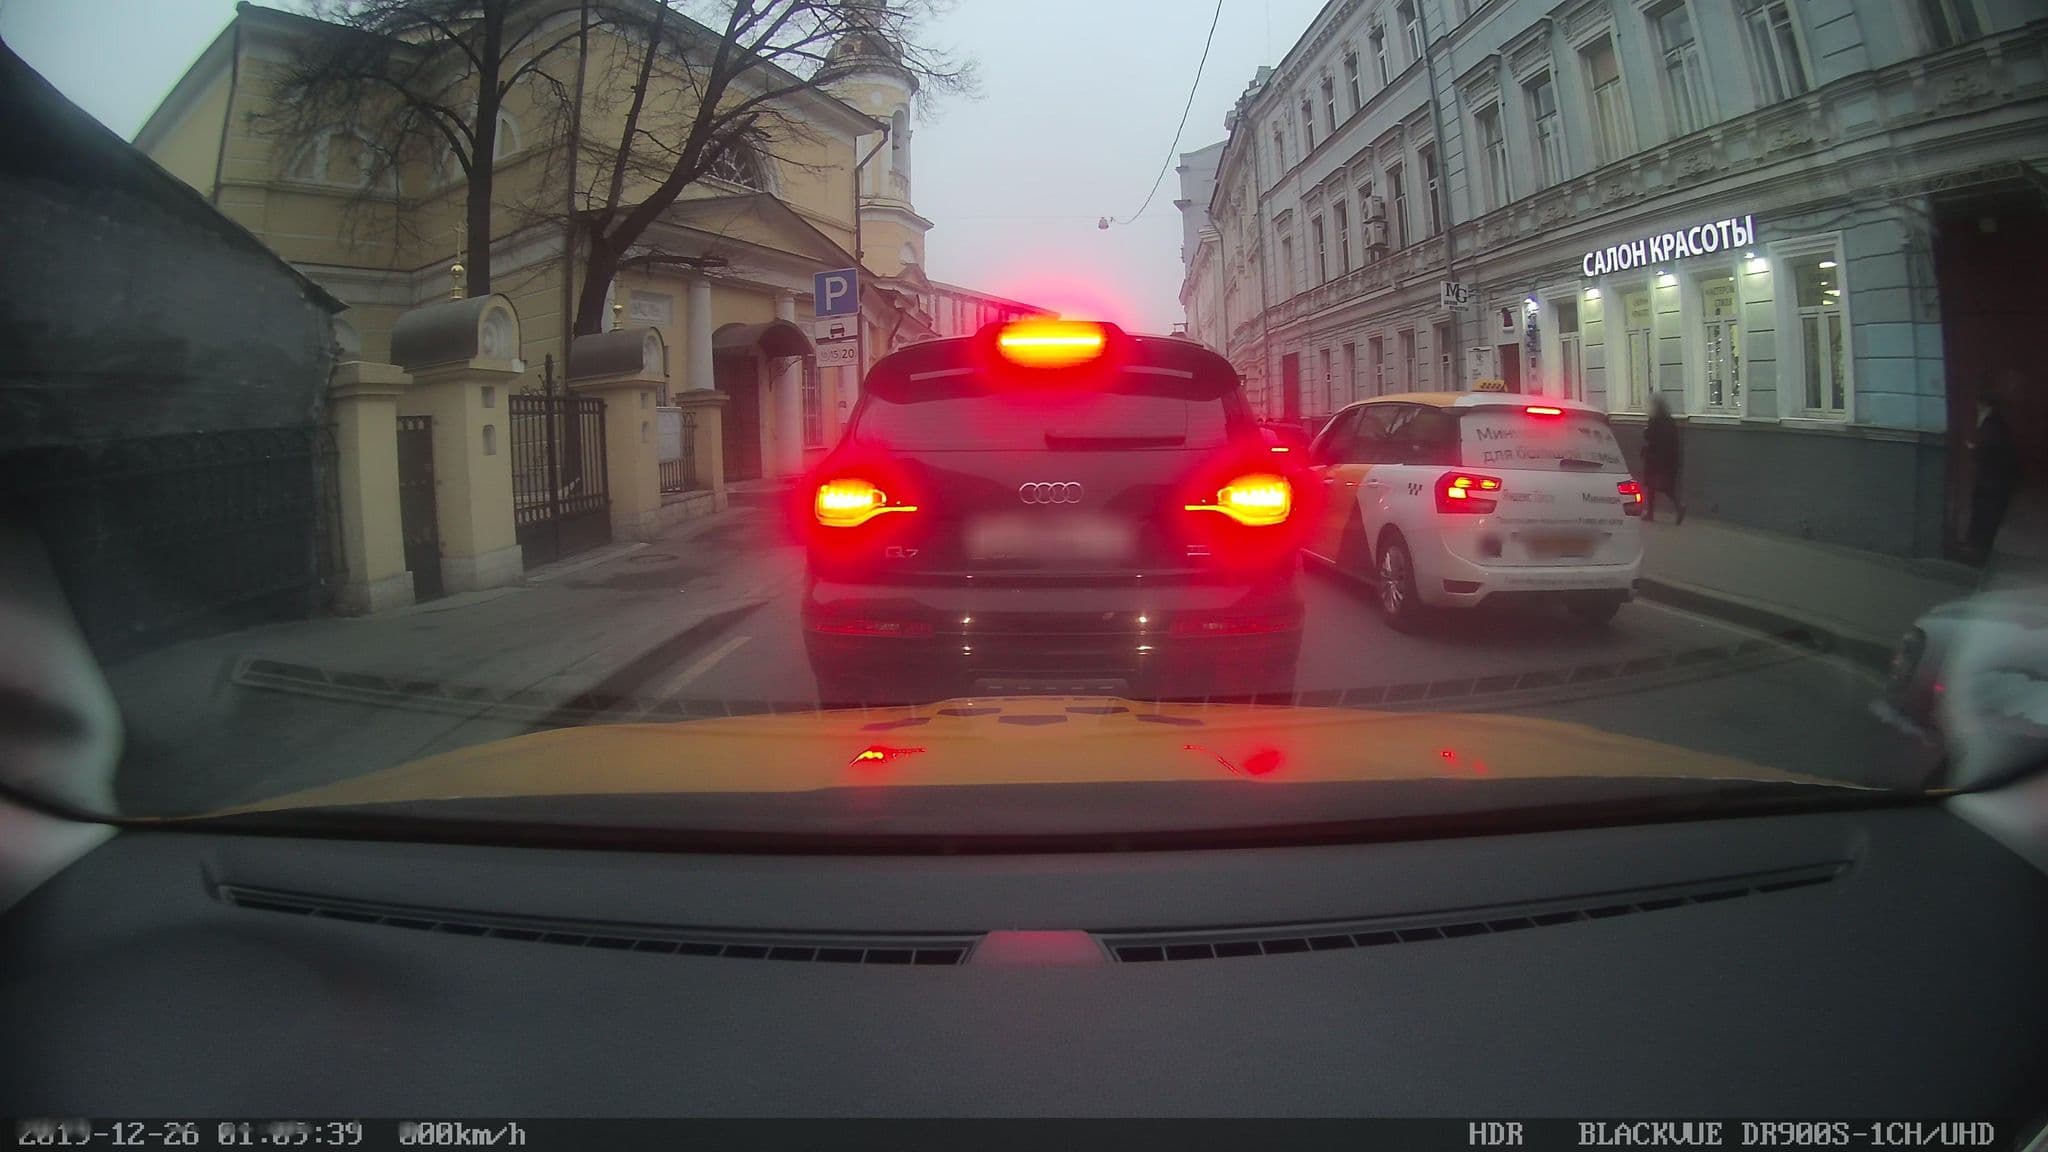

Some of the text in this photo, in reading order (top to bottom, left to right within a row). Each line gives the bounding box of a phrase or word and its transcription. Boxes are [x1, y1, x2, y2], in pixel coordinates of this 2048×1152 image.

[1583, 215, 1753, 277] САЛОН КРАСОТЫ
[825, 276, 848, 311] P
[842, 348, 855, 359] 20
